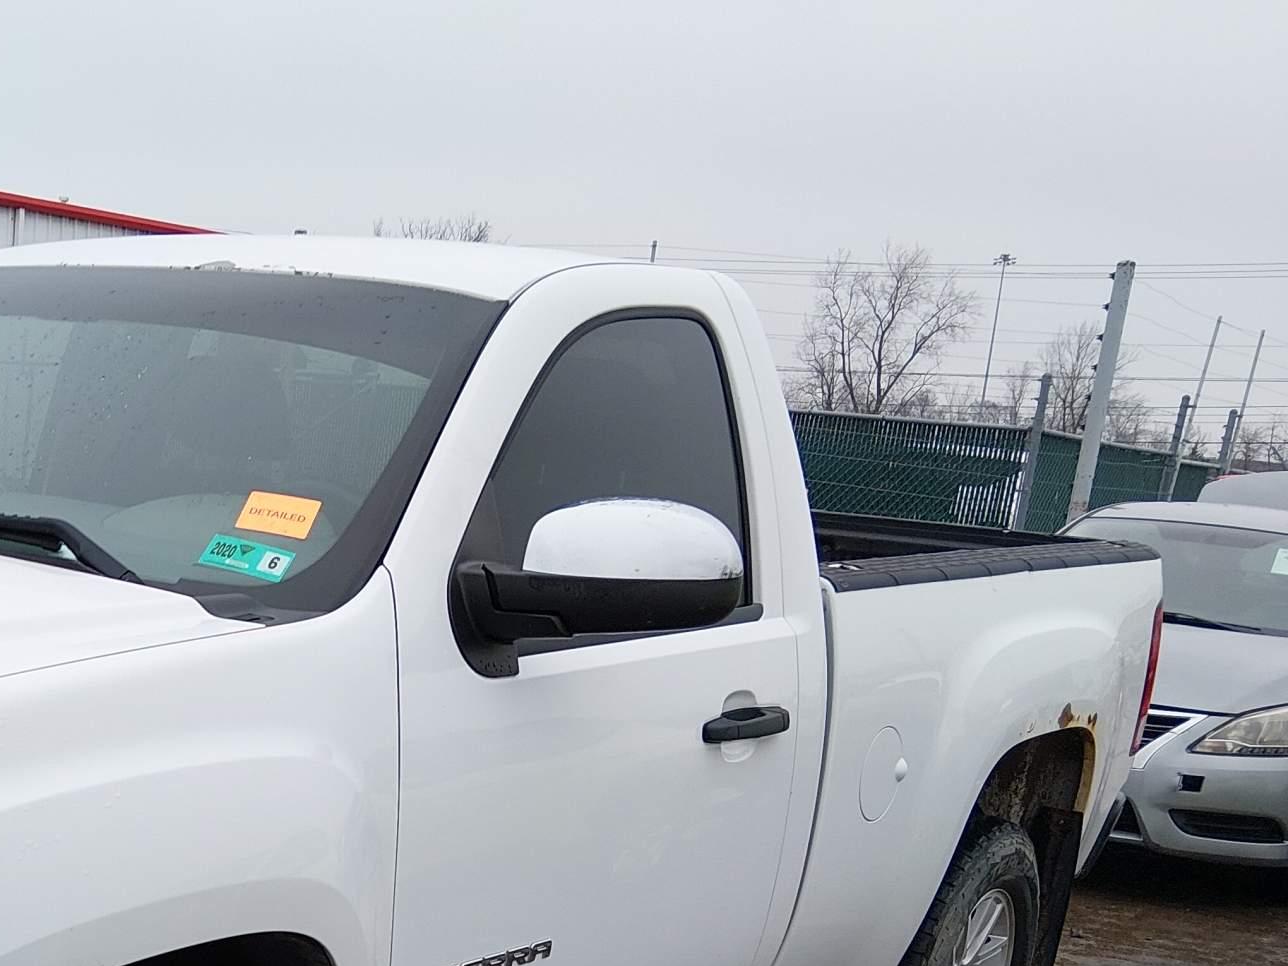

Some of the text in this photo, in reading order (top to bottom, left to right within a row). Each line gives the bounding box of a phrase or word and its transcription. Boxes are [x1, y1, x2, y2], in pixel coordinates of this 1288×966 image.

[249, 507, 306, 523] DETAILED
[210, 542, 280, 569] 2020 6
